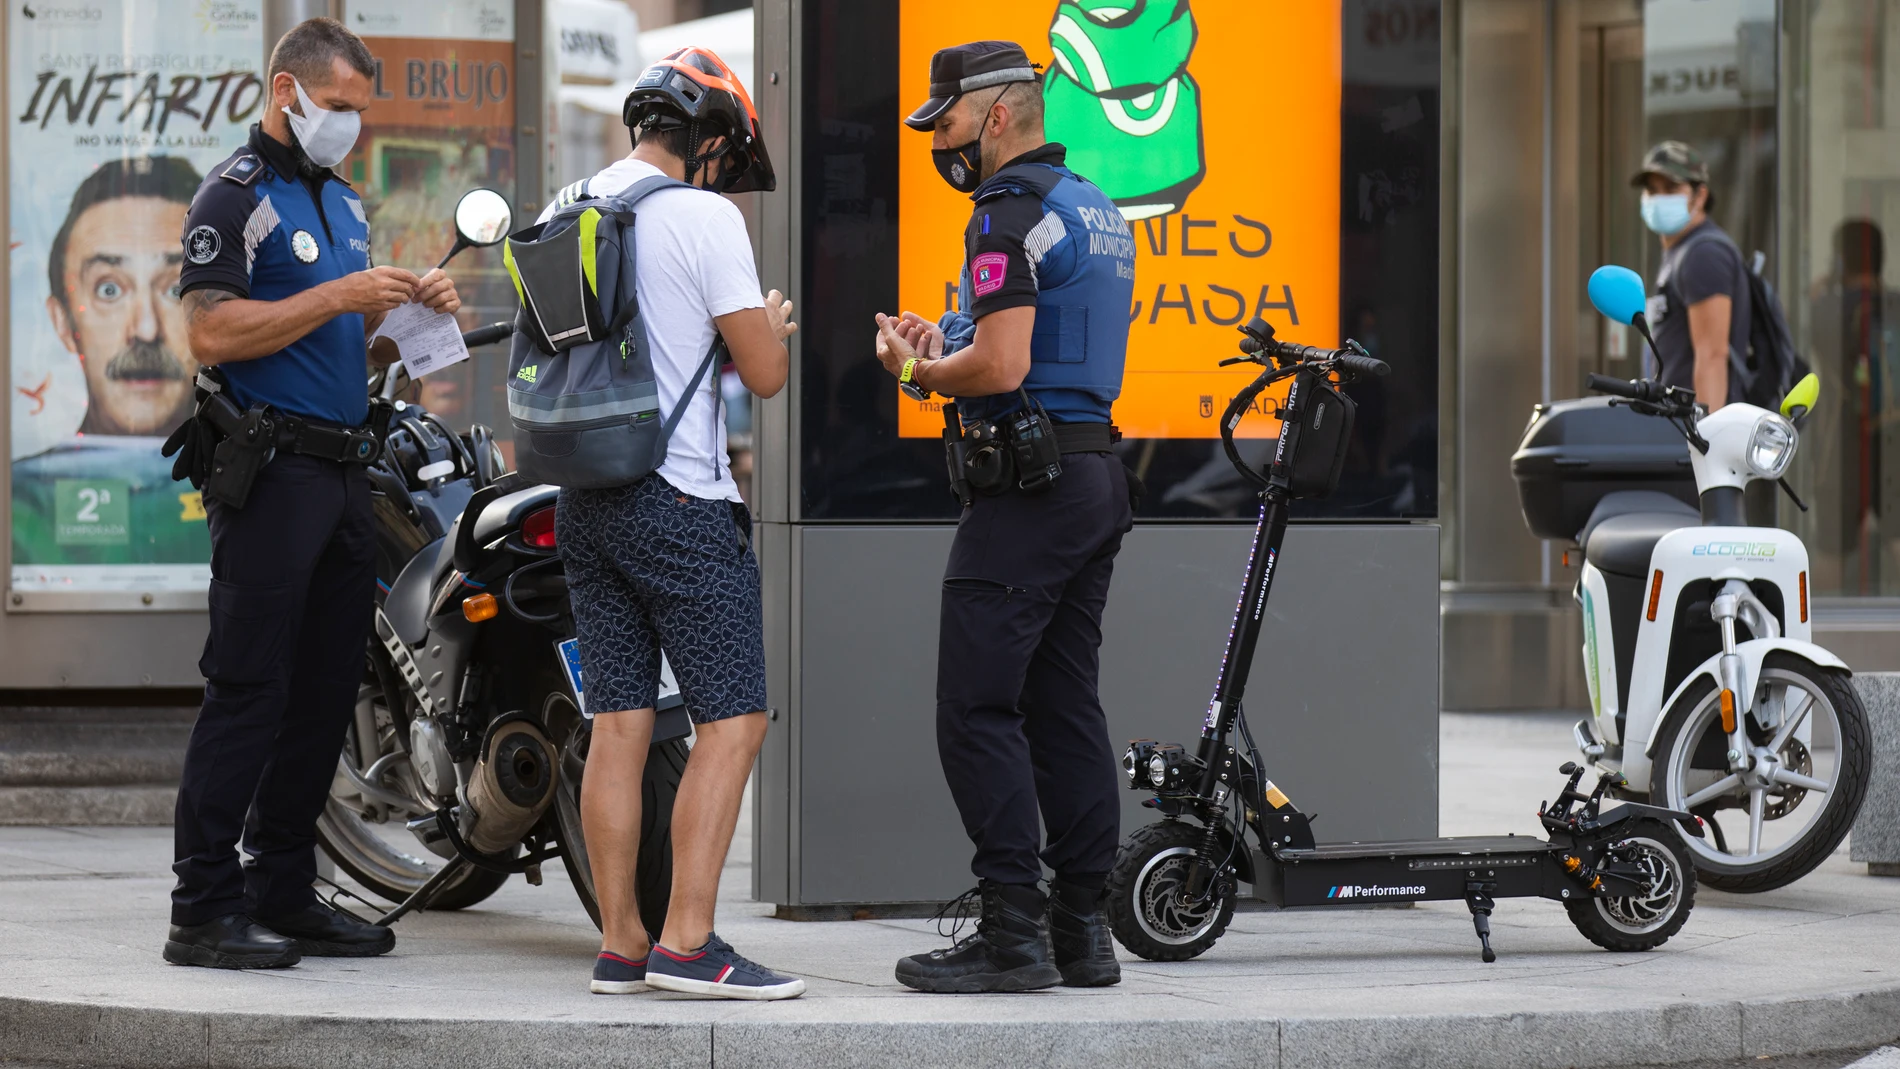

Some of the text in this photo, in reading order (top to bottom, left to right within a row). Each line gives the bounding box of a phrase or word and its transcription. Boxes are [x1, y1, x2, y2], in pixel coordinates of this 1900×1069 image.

[19, 65, 263, 134] INFARTO
[406, 60, 508, 110] BRUJO
[1275, 381, 1298, 462] PERFORANCE
[60, 524, 126, 536] TEMPORADA
